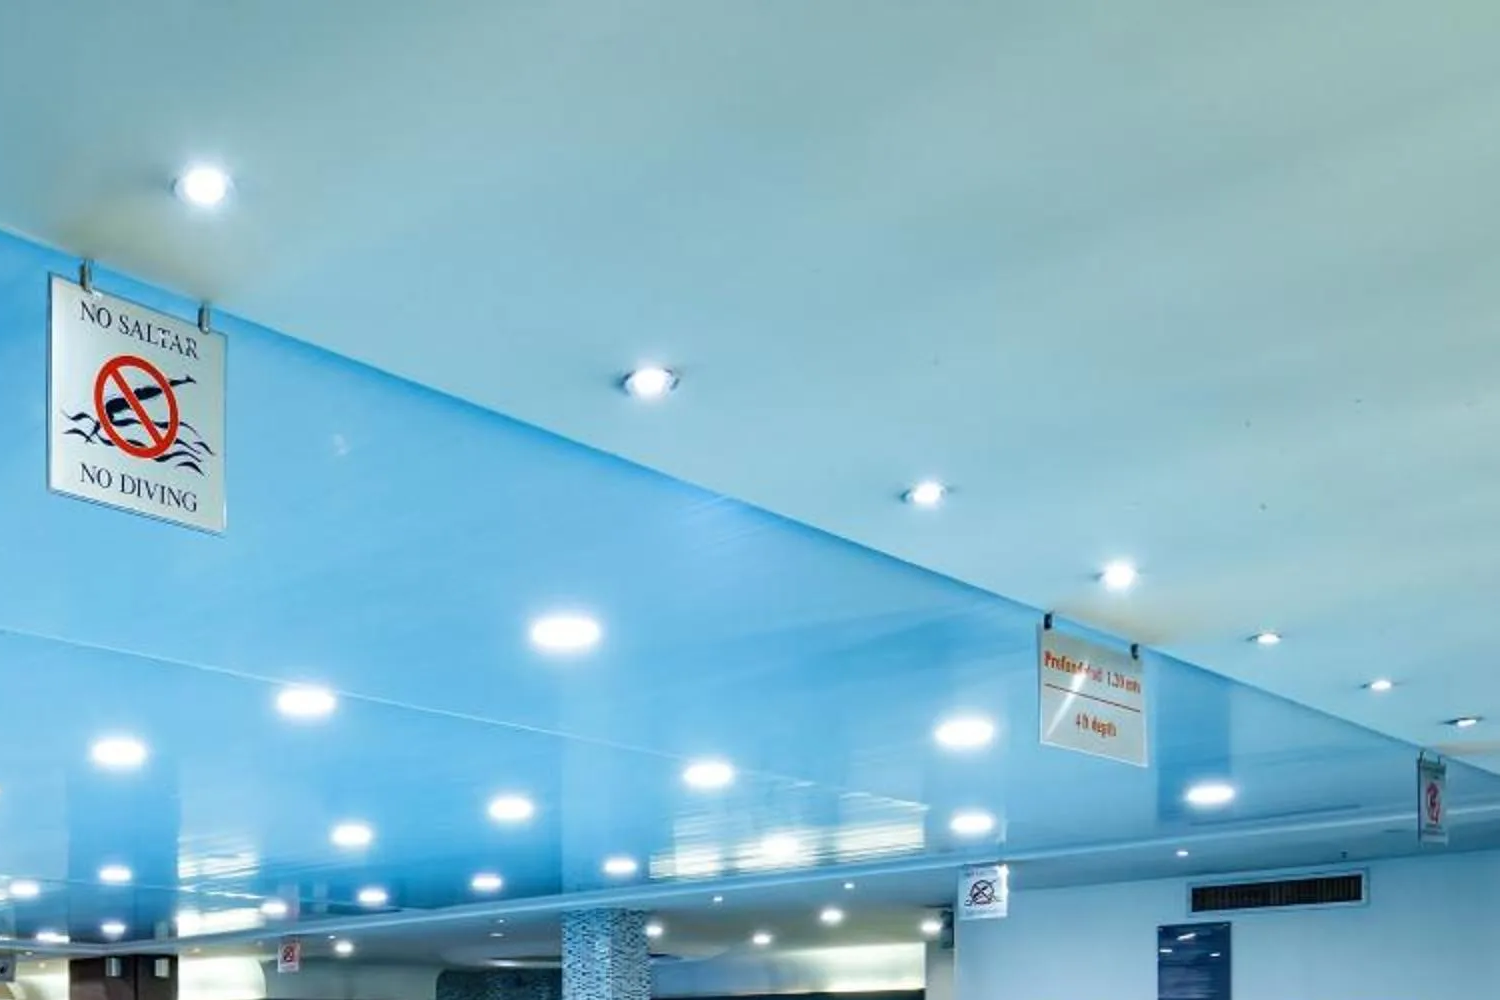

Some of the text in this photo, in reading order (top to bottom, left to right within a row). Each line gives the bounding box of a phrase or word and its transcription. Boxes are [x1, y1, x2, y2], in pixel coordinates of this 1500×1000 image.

[80, 301, 199, 360] NO SALTAR
[80, 463, 198, 513] NO DIVING
